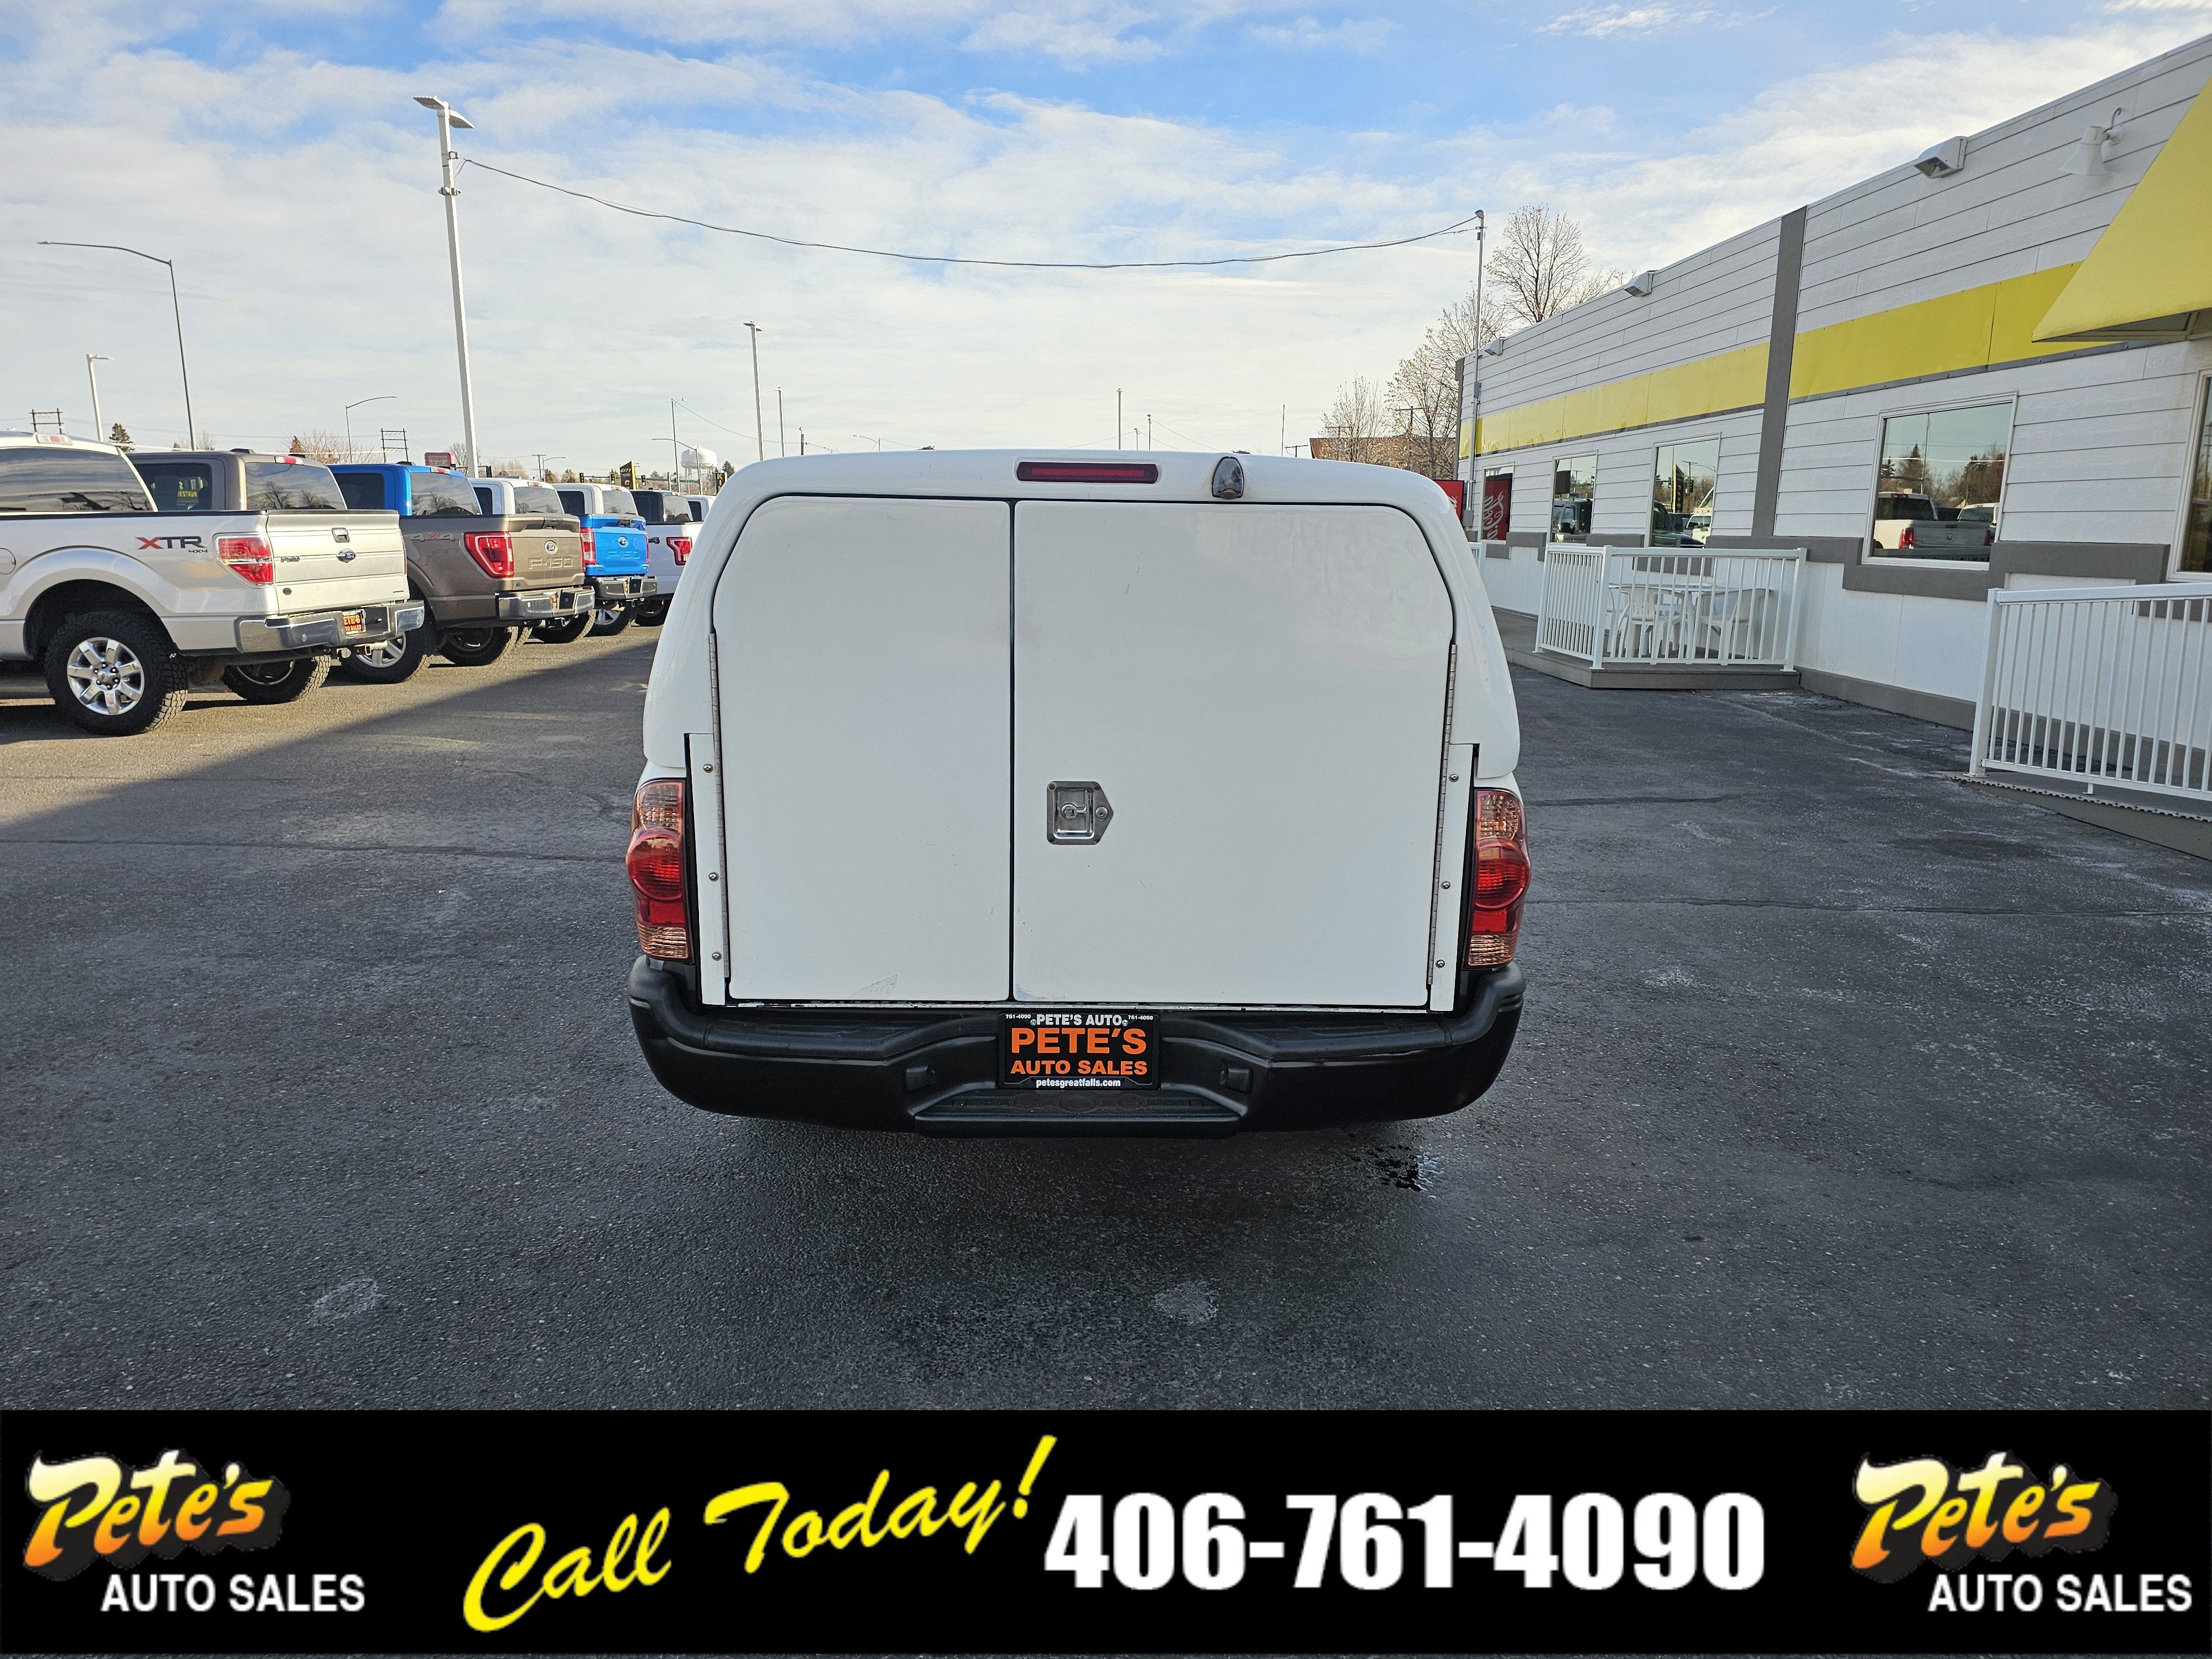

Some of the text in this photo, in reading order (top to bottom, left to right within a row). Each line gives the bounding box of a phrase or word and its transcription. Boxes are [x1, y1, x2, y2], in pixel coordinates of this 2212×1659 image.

[135, 536, 207, 550] XTR
[528, 556, 573, 569] F-150
[1037, 1014, 1121, 1025] PETE'S AUTO
[1012, 1028, 1146, 1054] PETE'S
[1011, 1061, 1147, 1074] AUTO SALES
[1036, 1078, 1121, 1088] petesgreatfalls.com
